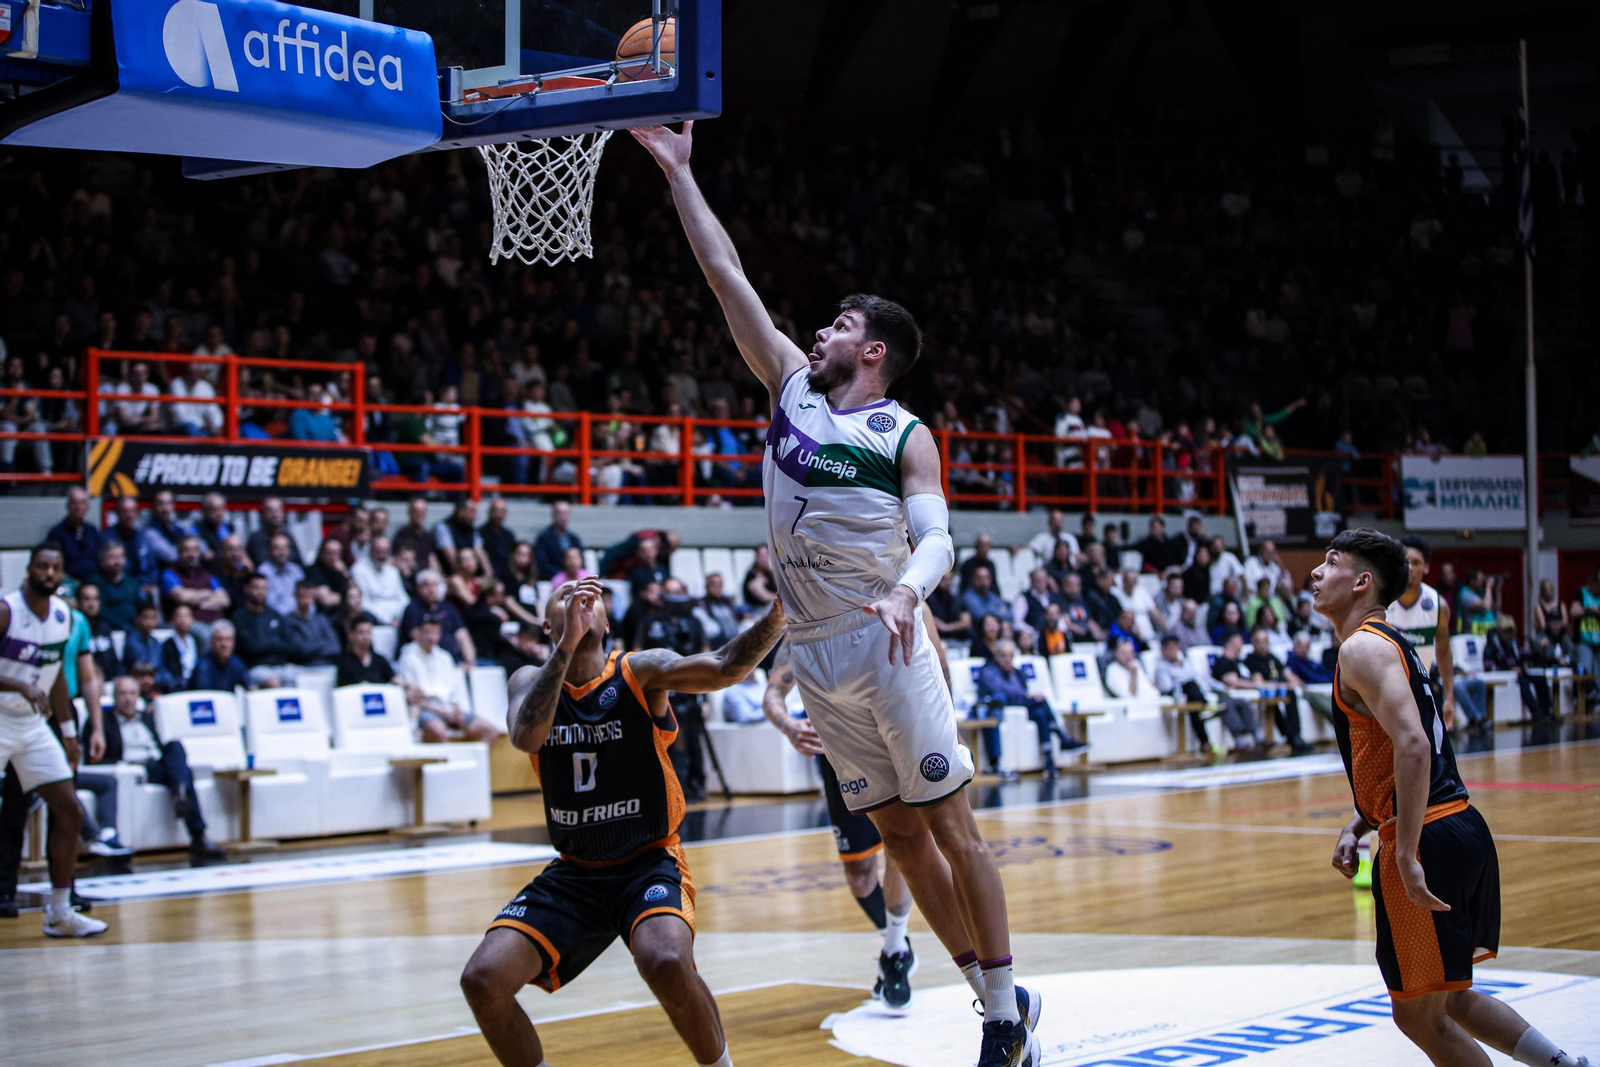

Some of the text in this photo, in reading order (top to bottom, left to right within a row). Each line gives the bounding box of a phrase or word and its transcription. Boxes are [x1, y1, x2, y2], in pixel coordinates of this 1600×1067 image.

[243, 19, 403, 91] affidea
[134, 453, 362, 487] #PROUD TO BE ORANGE!
[798, 449, 857, 479] Unicaja
[791, 495, 808, 535] 7
[572, 752, 598, 793] 0
[550, 799, 640, 826] MED FRIGO
